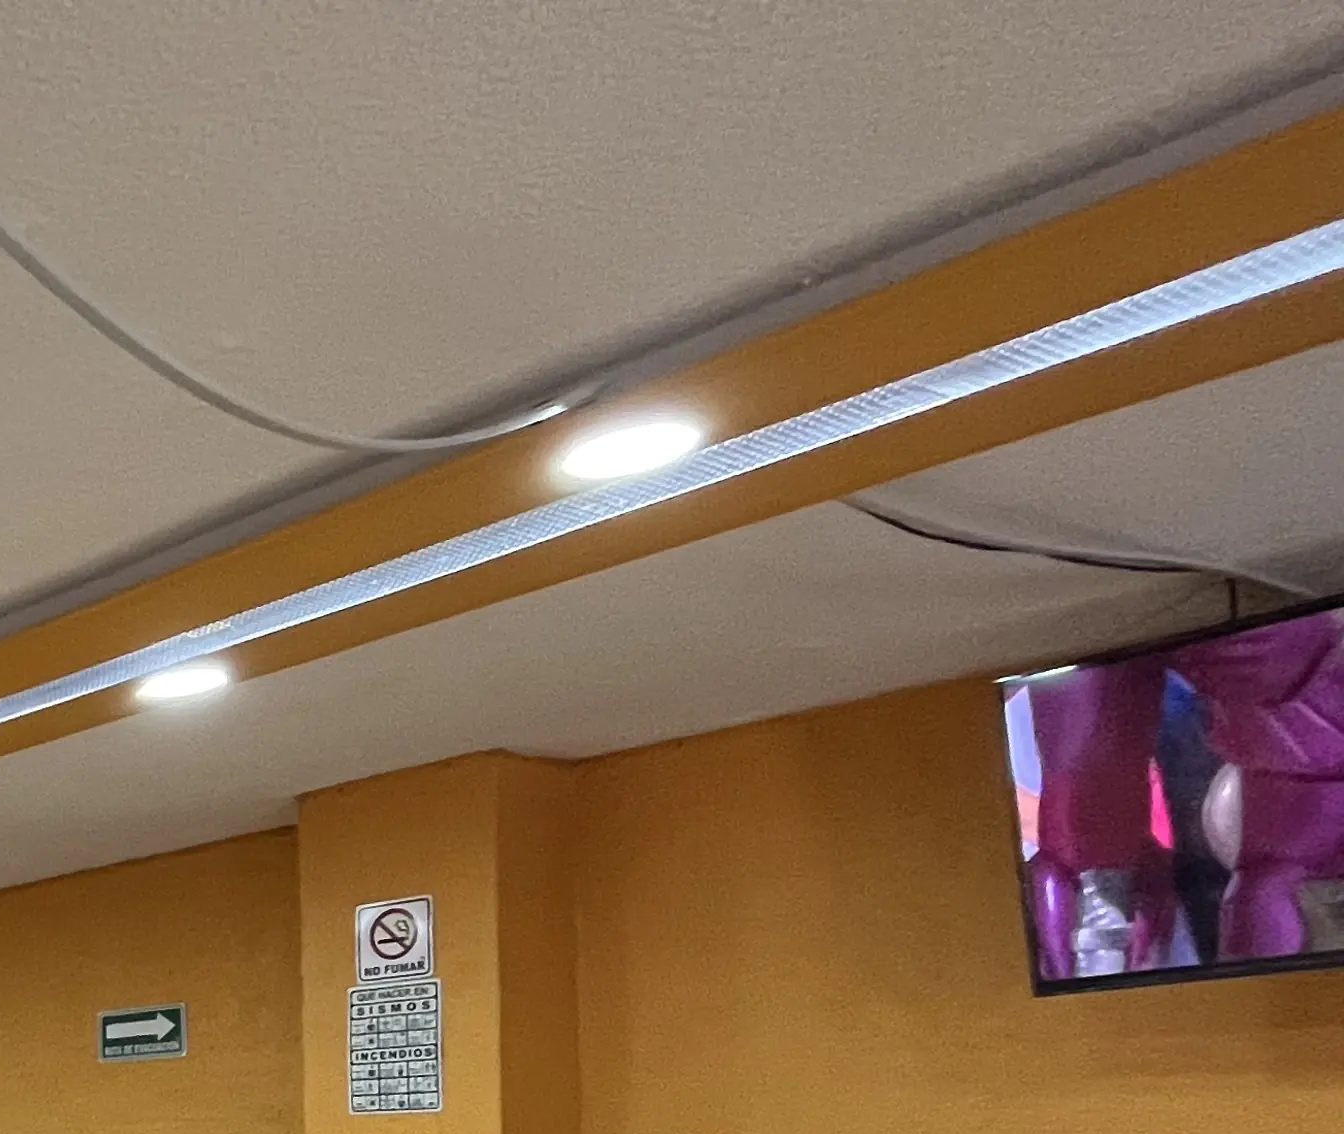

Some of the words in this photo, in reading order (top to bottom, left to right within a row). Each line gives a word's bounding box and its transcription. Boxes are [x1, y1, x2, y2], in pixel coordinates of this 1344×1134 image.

[364, 966, 381, 977] NO
[384, 961, 426, 975] FUMAR
[356, 1001, 431, 1017] SISMOS
[355, 1047, 433, 1061] INCENDIOS
